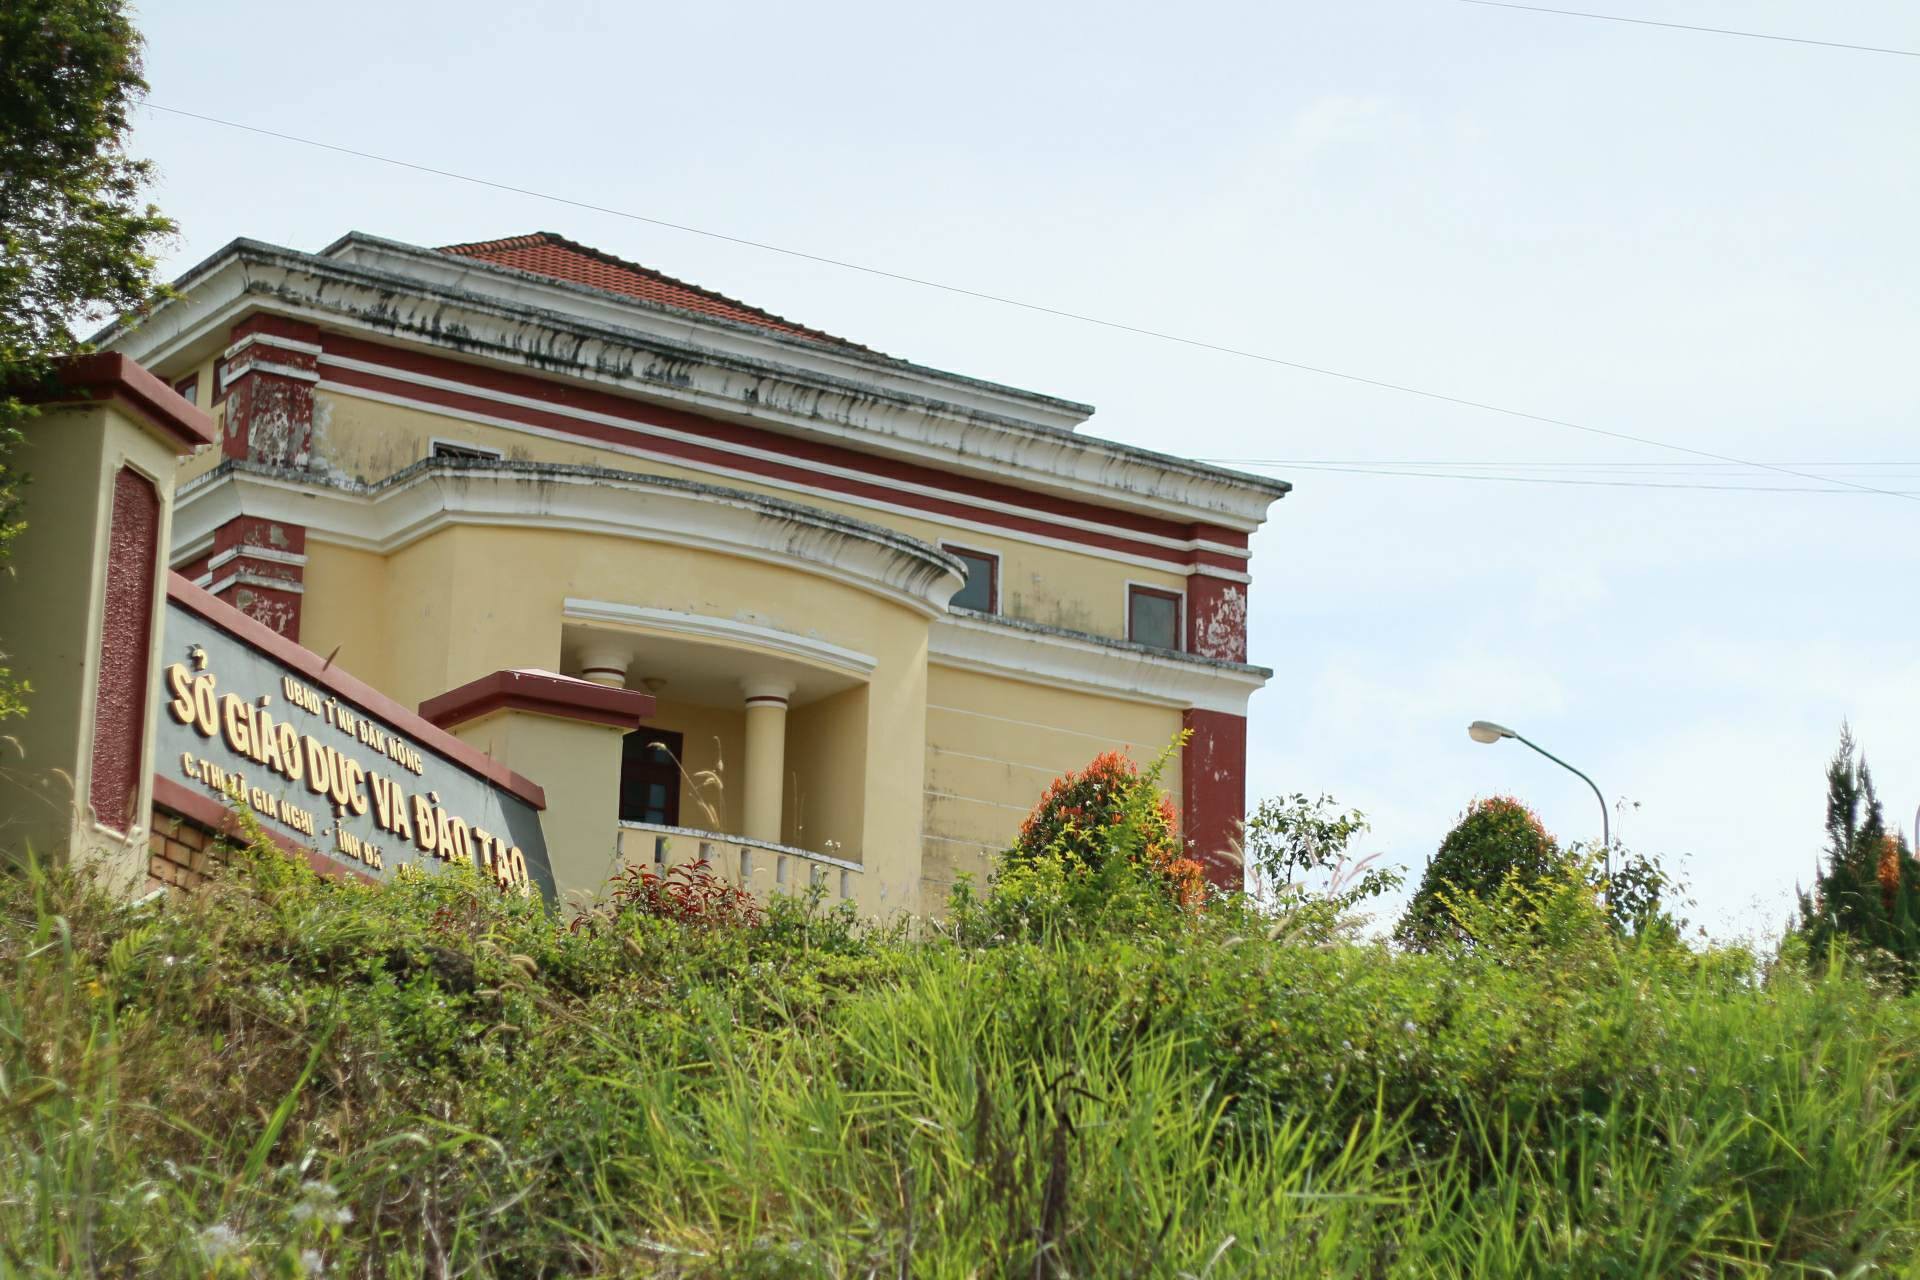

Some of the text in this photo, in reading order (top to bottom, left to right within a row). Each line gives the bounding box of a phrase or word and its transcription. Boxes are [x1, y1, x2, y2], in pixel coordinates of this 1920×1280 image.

[167, 646, 219, 737] SỞ
[220, 692, 304, 781] GIÁO
[301, 735, 368, 818] DỤC
[410, 791, 473, 863] ĐÀO
[282, 676, 320, 715] UBND
[386, 736, 423, 776] NÔNG
[250, 787, 278, 819] GIA
